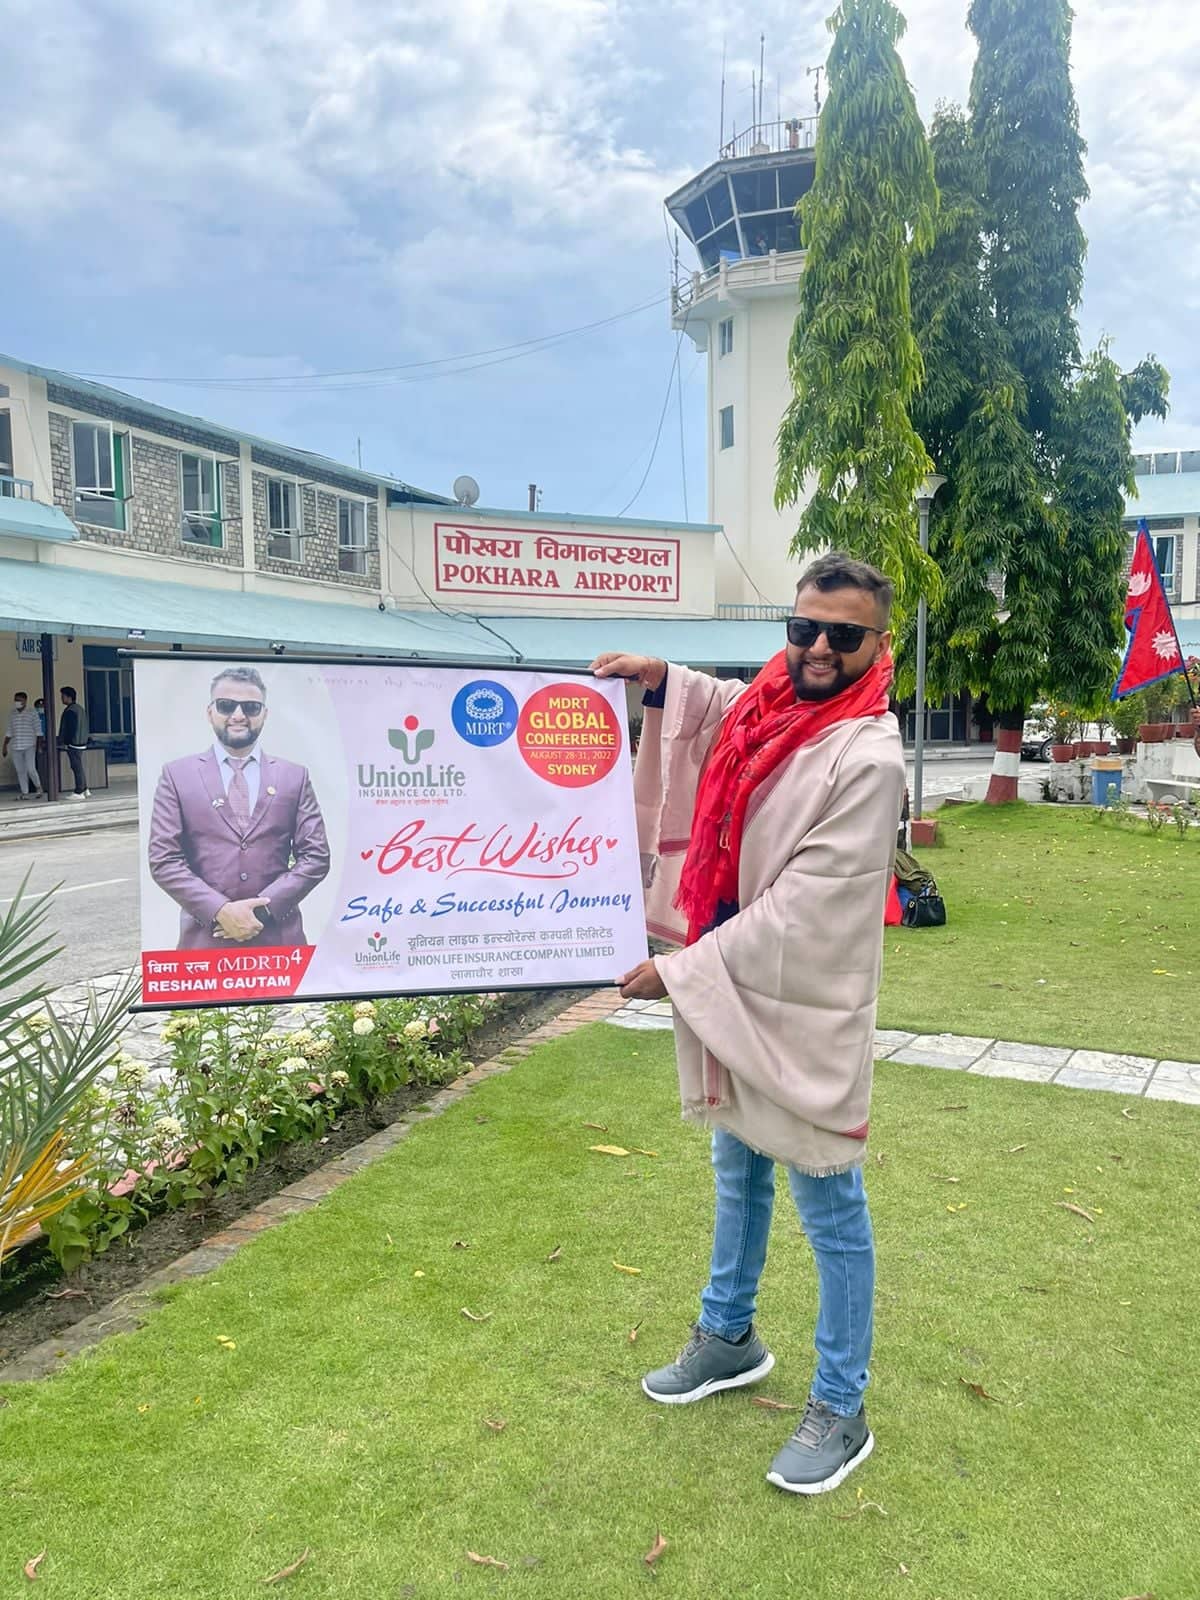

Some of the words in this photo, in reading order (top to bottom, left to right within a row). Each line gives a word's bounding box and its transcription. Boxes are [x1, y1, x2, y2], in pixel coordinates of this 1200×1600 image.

[443, 530, 523, 558] पोखरा
[534, 536, 672, 567] विमानस्थल
[443, 563, 560, 588] POKHARA
[574, 571, 673, 593] AIRPORT
[22, 638, 35, 653] AIR
[548, 697, 590, 710] MDRT
[529, 711, 610, 730] GLOBAL
[525, 732, 615, 746] CONFERENCE
[530, 750, 562, 760] AUGUST
[593, 751, 612, 760] 2022
[358, 764, 466, 788] UnionLife
[547, 763, 597, 776] SYDNEY
[359, 788, 418, 798] INSURANCE
[422, 788, 440, 797] CO.
[443, 788, 466, 797] LTD.
[376, 819, 485, 876] Best
[478, 816, 604, 868] Wishes
[340, 895, 403, 924] Safe
[409, 898, 427, 915] &
[430, 891, 545, 918] Successful
[550, 888, 632, 914] Journey
[448, 934, 479, 947] लाइफ
[354, 950, 401, 963] UnionLife
[407, 954, 441, 967] UNION
[442, 953, 464, 964] LIFE
[464, 949, 522, 963] INSURANCE
[523, 948, 574, 960] COMPANY
[575, 945, 615, 958] LIMITED
[498, 966, 524, 977] शाखा
[148, 979, 218, 993] RESHAM
[222, 976, 291, 990] GAUTAM
